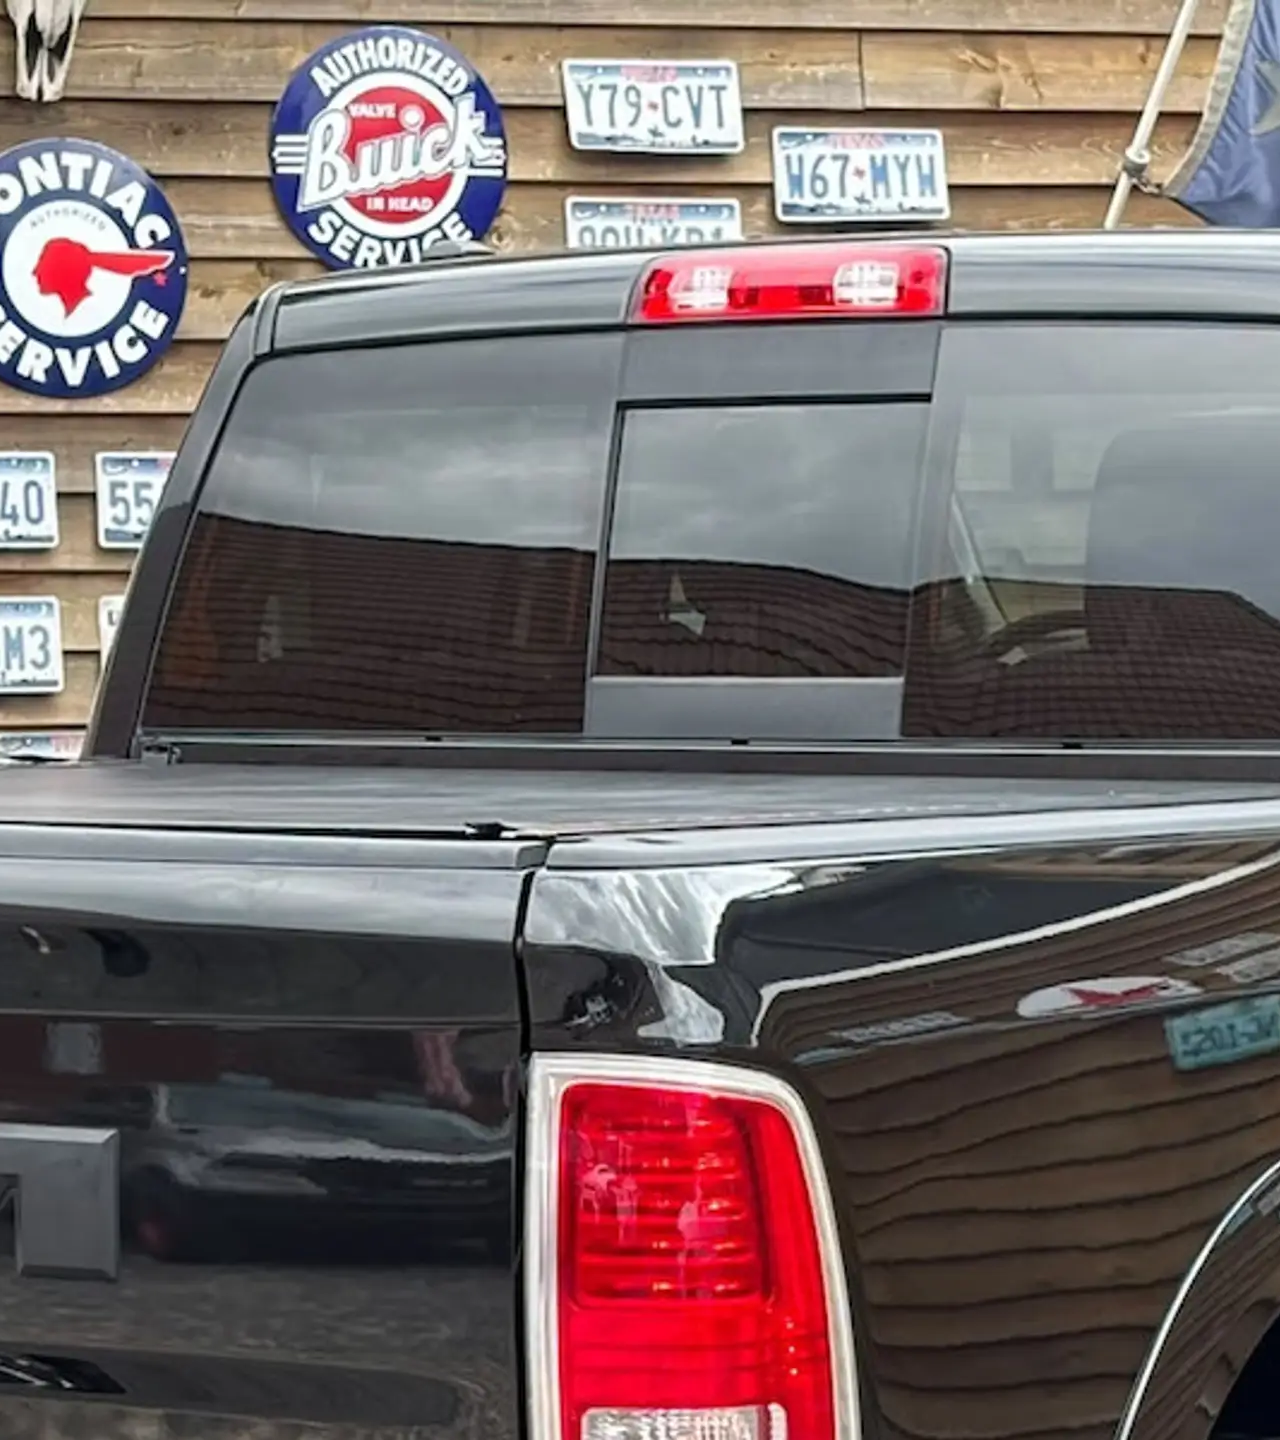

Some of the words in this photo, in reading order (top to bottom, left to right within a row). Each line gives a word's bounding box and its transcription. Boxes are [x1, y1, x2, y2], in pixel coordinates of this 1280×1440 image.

[310, 37, 469, 97] AUTHORIZED
[297, 92, 507, 212] Buick
[366, 198, 384, 211] IN
[388, 198, 434, 212] HEAD
